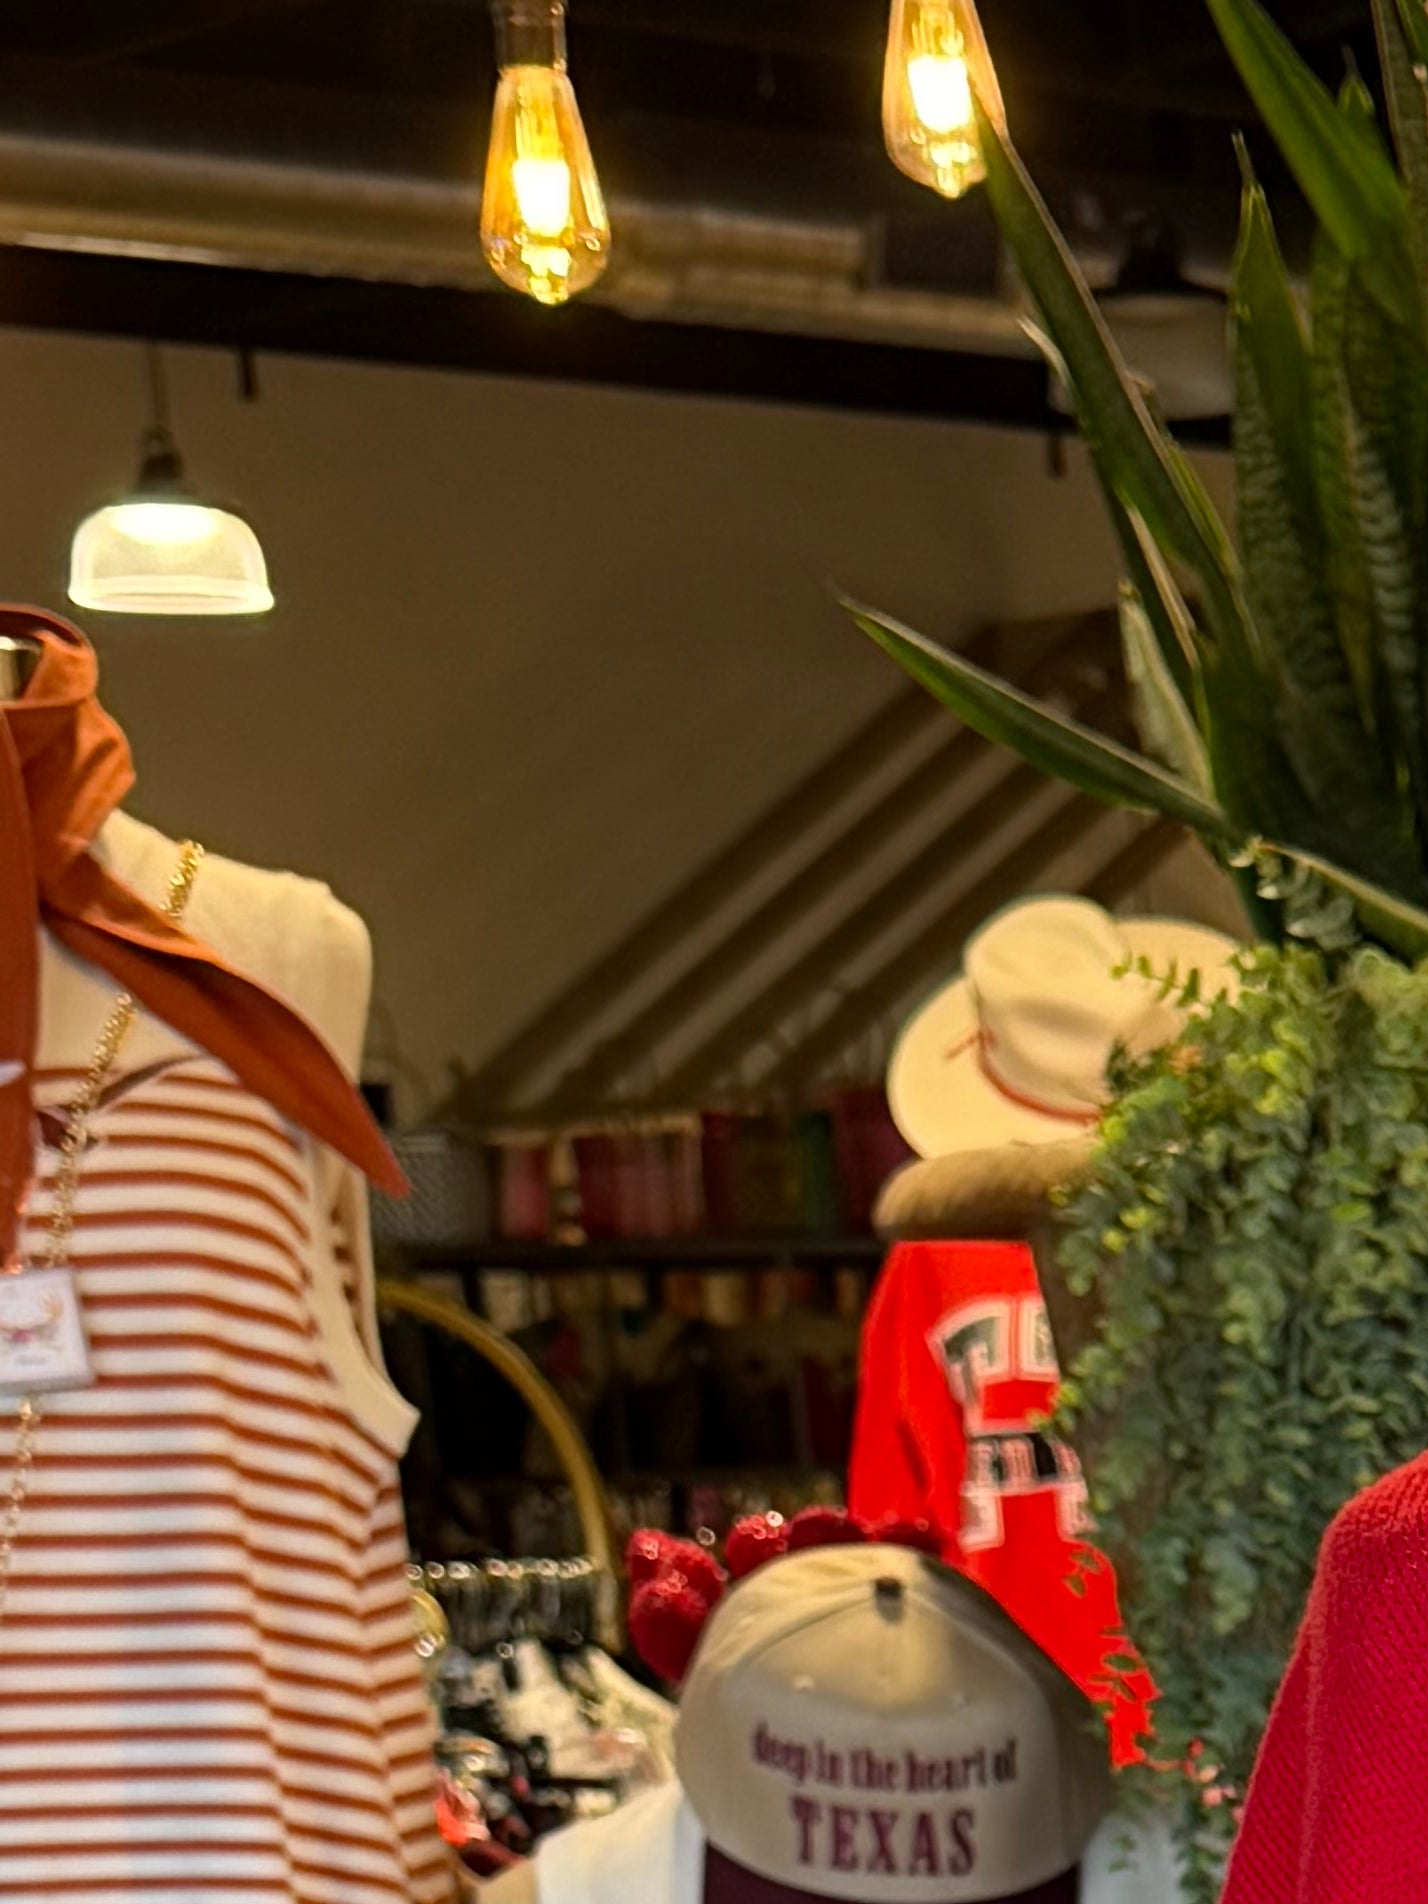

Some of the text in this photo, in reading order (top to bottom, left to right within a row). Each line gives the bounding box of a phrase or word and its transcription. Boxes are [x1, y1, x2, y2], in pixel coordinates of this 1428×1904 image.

[849, 1745, 899, 1793] the
[904, 1746, 987, 1794] heart
[790, 1795, 977, 1879] TEXAS
